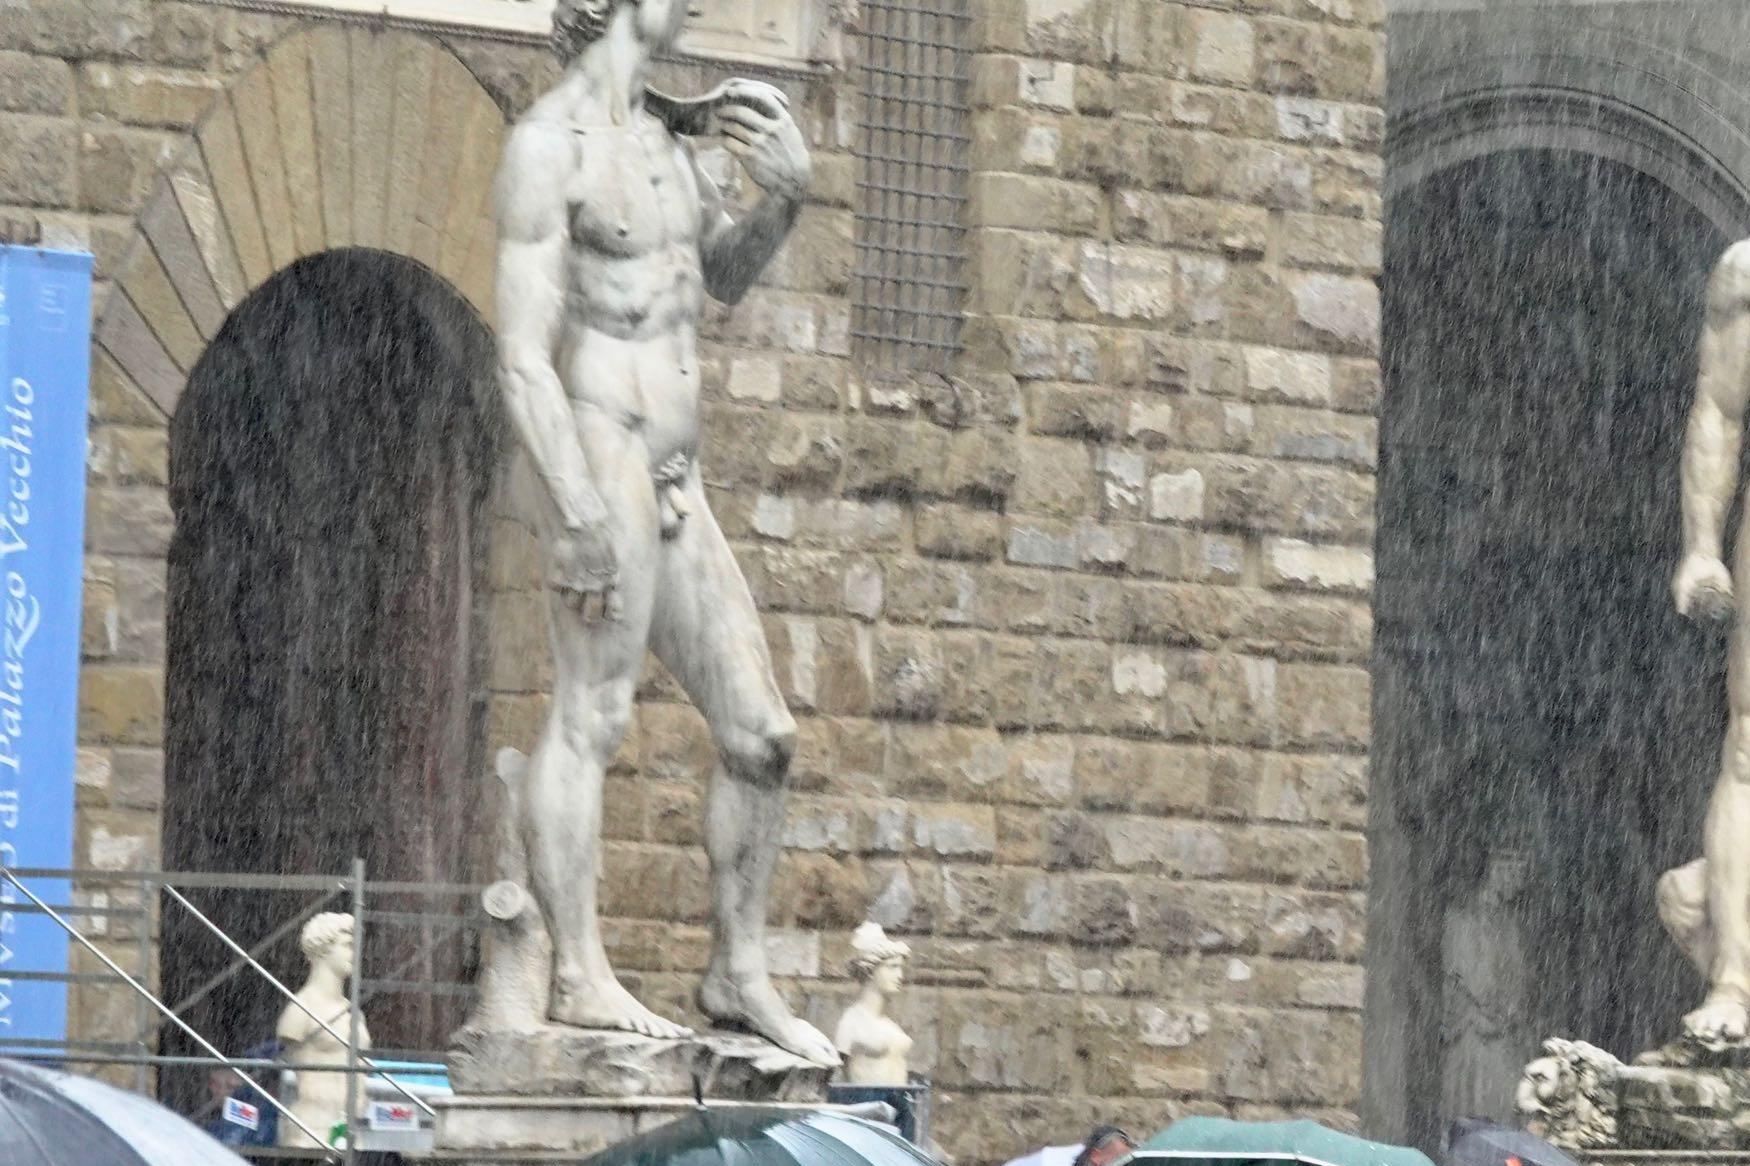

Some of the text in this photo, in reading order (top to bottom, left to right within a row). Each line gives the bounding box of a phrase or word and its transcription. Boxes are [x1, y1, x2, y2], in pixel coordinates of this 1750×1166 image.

[0, 377, 34, 559] Vecchio
[0, 571, 40, 774] Palazzo
[0, 790, 19, 829] di
